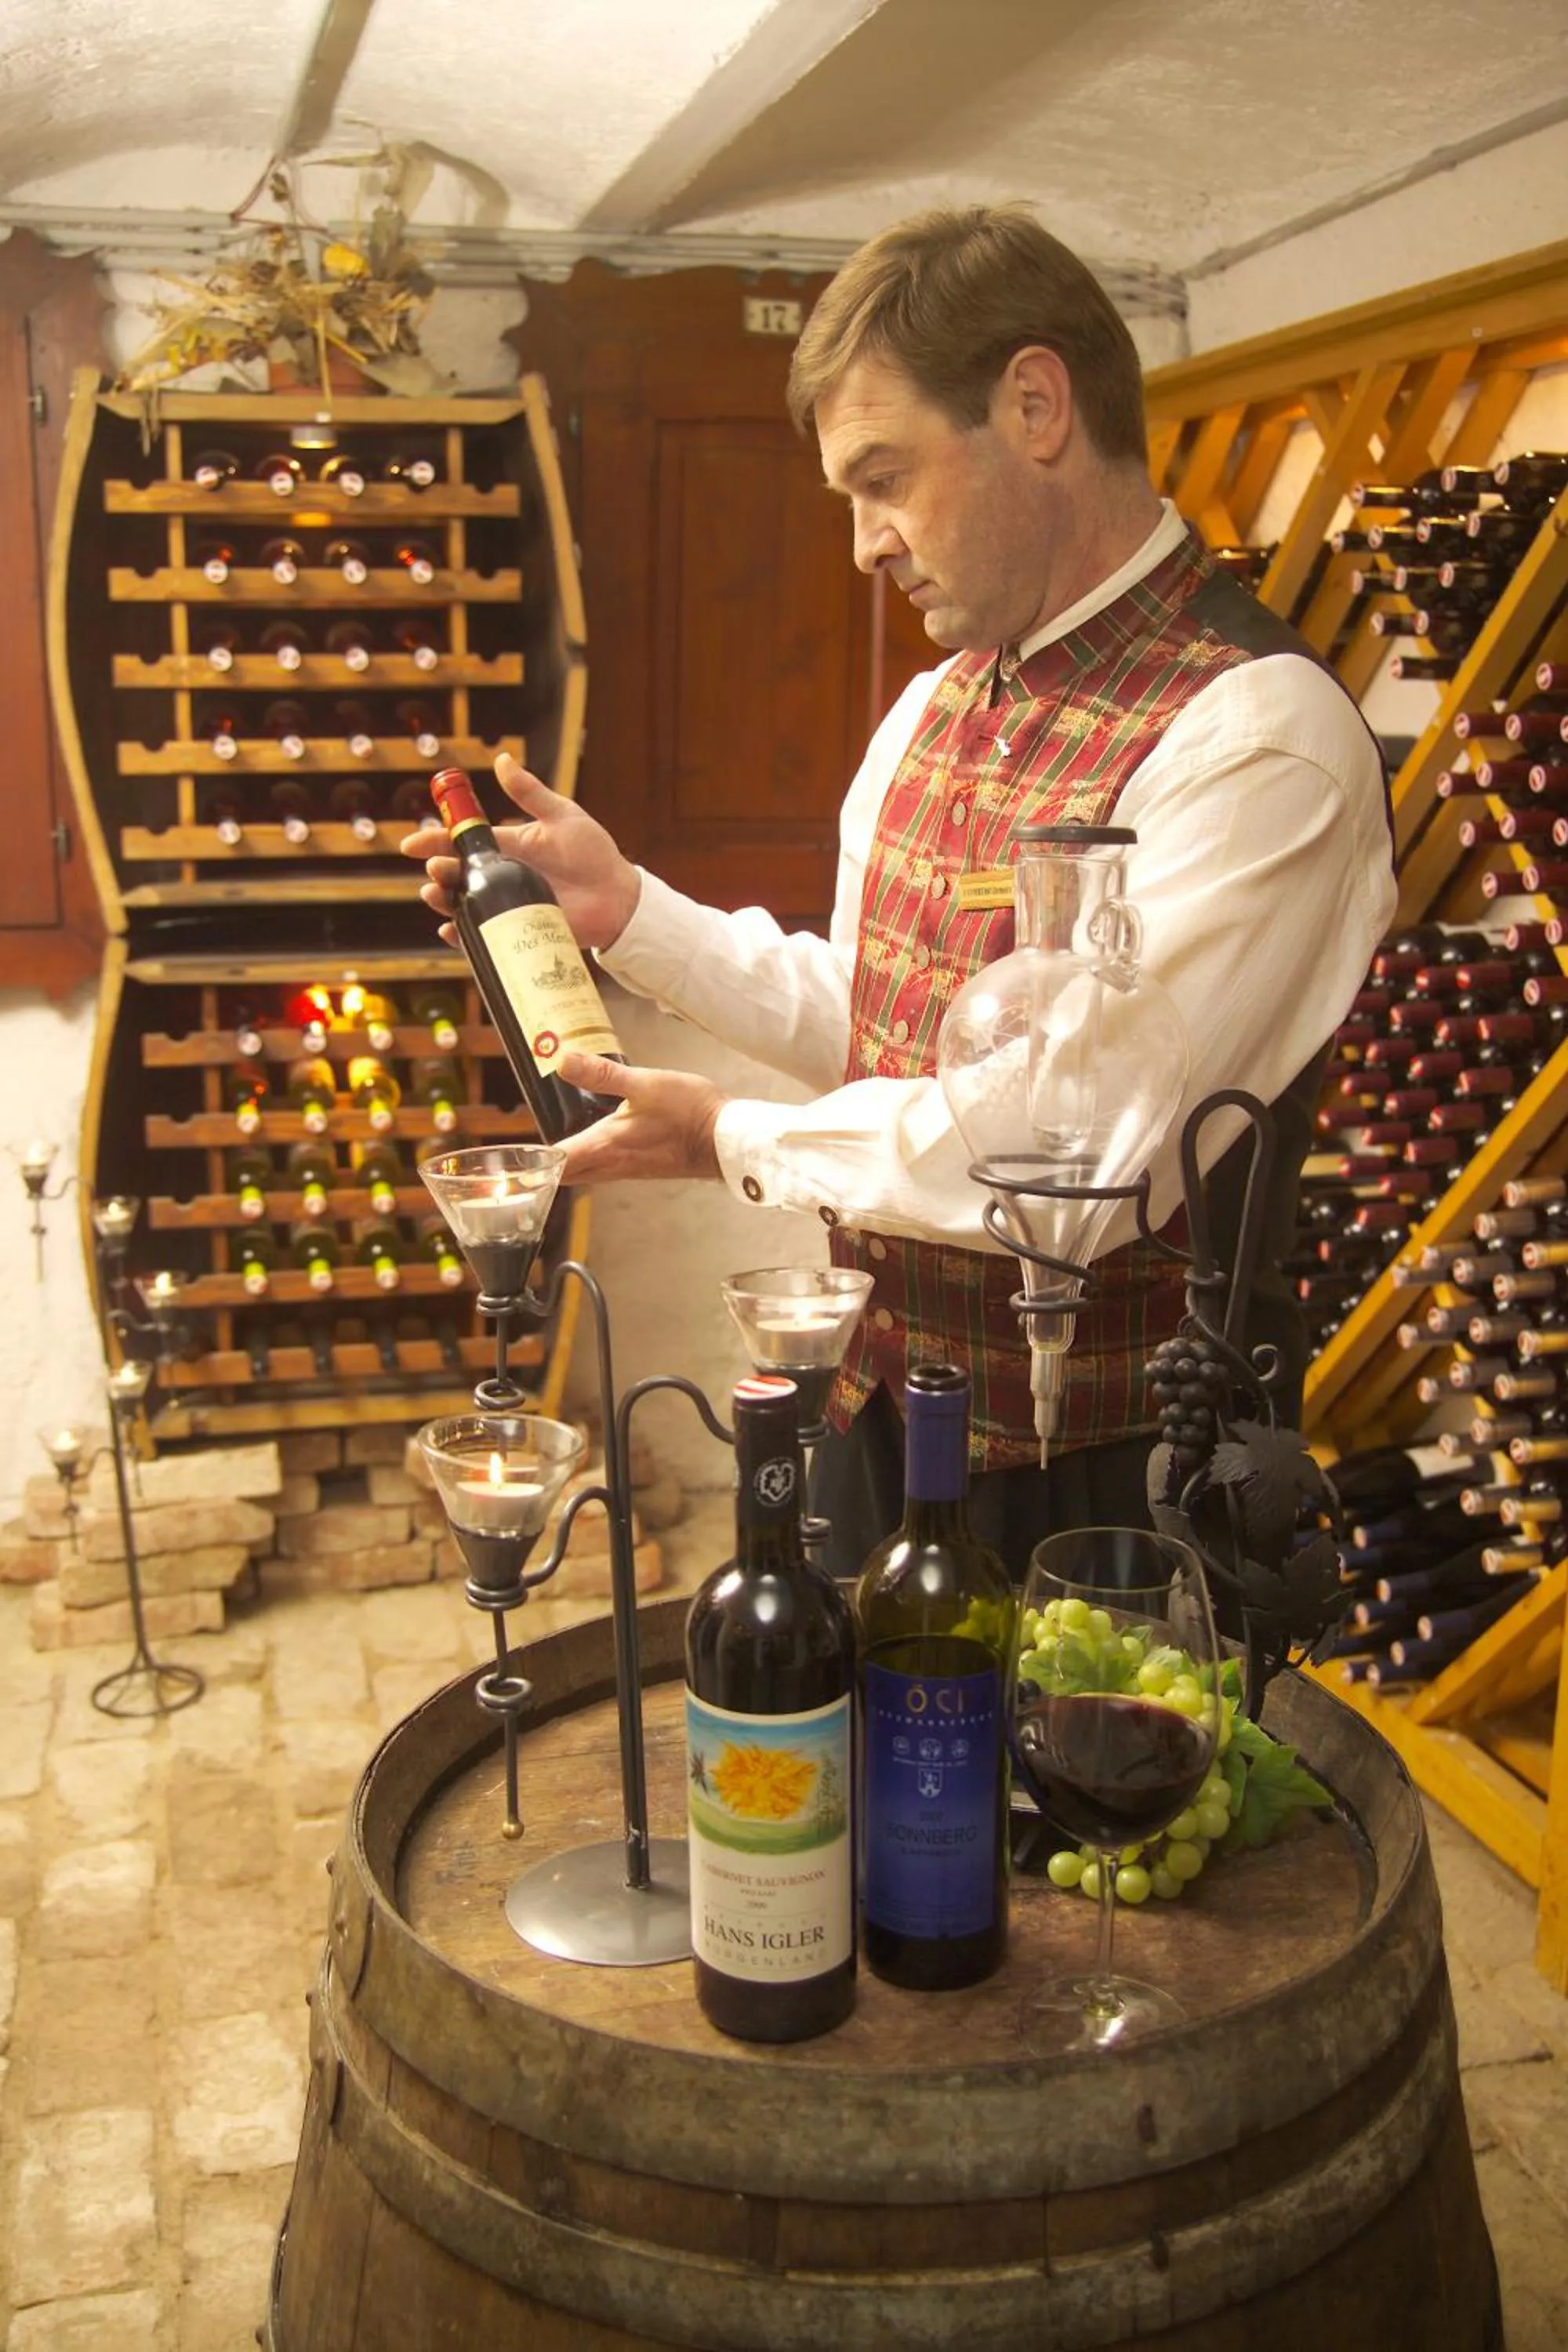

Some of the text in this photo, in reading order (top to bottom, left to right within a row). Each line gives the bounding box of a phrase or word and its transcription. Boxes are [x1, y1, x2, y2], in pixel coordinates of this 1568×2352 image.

[762, 304, 787, 332] 17
[704, 1915, 754, 1947] HANS
[762, 1926, 825, 1950] IGLER
